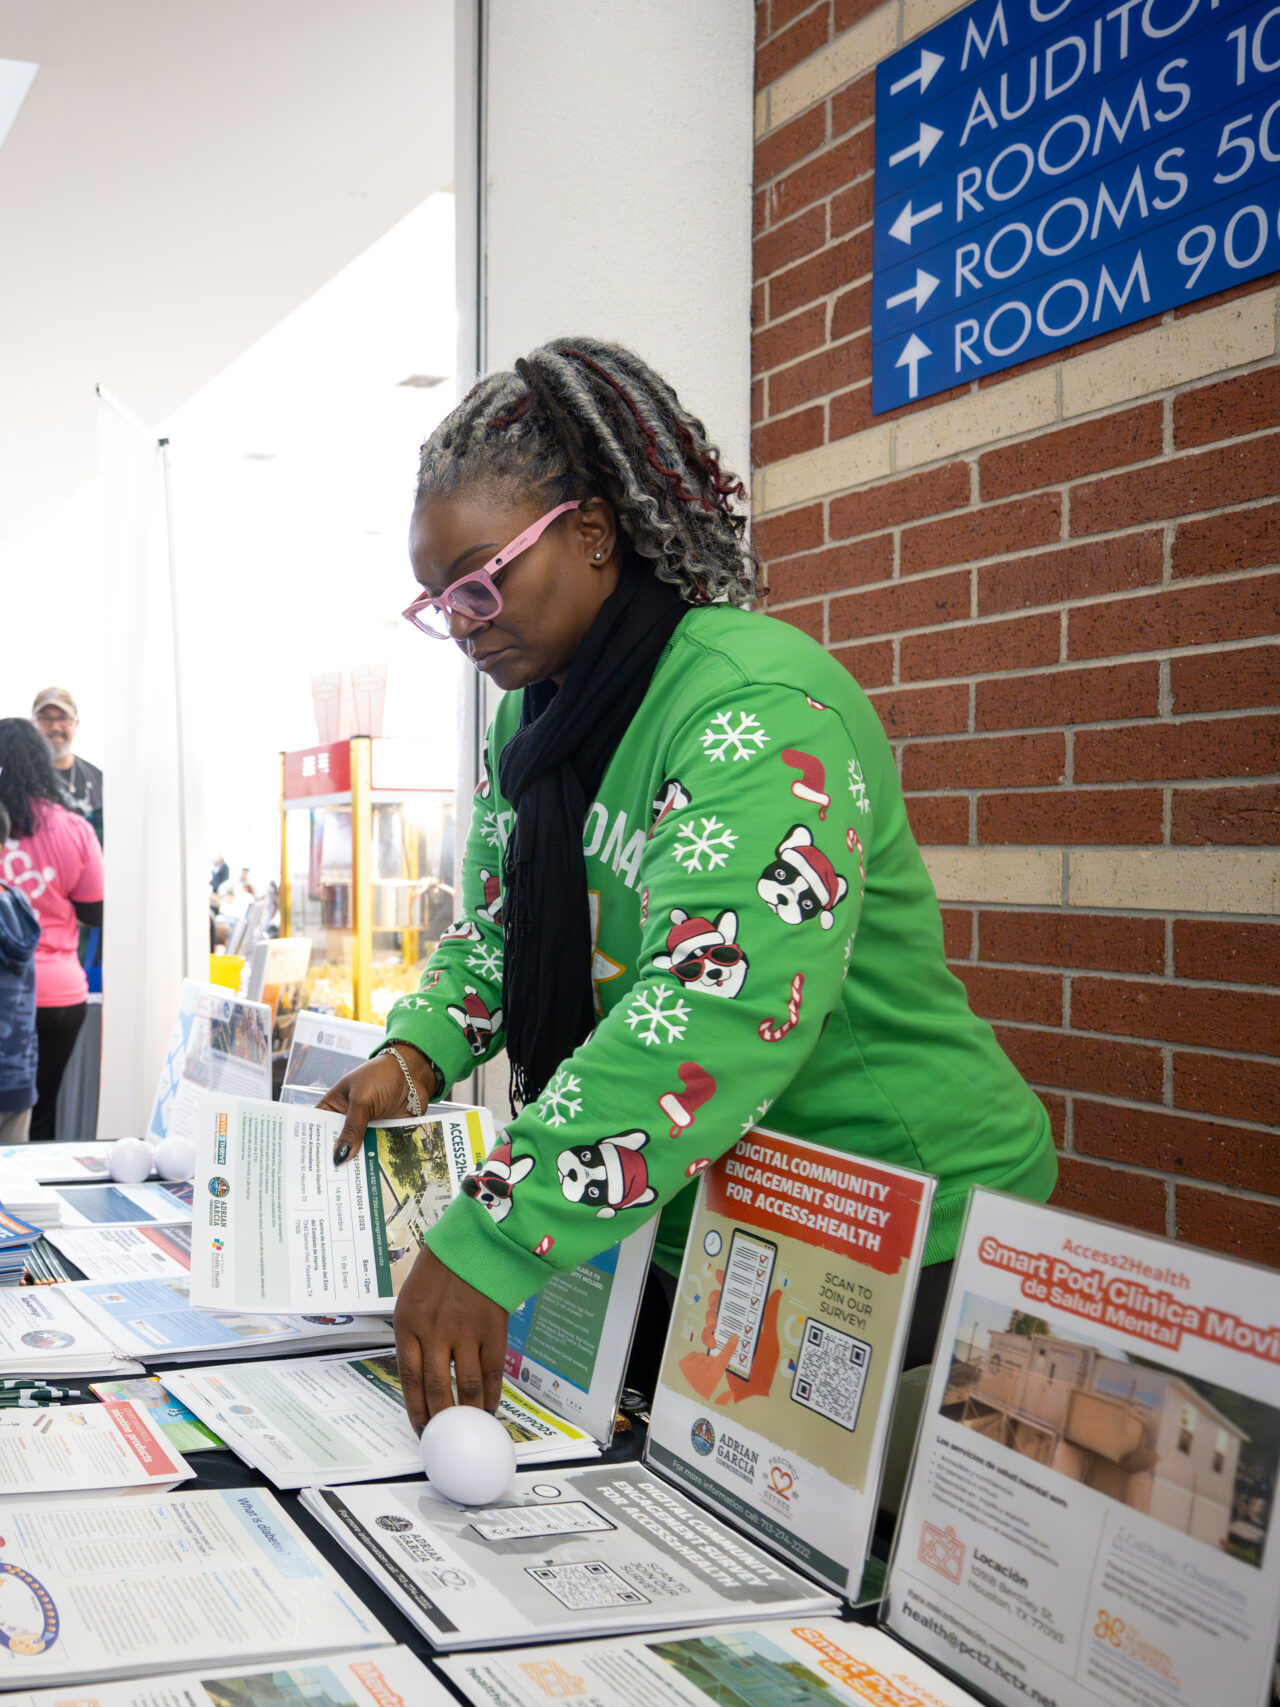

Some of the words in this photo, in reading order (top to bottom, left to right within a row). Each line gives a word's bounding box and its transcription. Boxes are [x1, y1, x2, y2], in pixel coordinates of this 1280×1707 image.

[959, 0, 1222, 147] AUDITO
[956, 58, 1191, 222] ROOMS
[955, 147, 1188, 298] ROOMS
[954, 249, 1151, 373] ROOM
[1177, 204, 1280, 289] 90
[735, 1139, 791, 1174] DIGITAL
[790, 1157, 891, 1204] COMMUNITY
[355, 1194, 364, 1210] 2024
[725, 1159, 825, 1209] ENGAGEMENT
[825, 1192, 891, 1229] SURVEY
[212, 1199, 220, 1226] GARCIA
[219, 1200, 227, 1228] ADRIAN
[335, 1202, 345, 1231] Diciembre
[357, 1214, 366, 1231] 2025
[726, 1182, 754, 1205] FOR
[754, 1192, 882, 1253] ACCESS2HEALTH
[341, 1270, 350, 1289] Enero
[361, 1259, 370, 1272] 8am
[981, 1239, 1050, 1281] Smart
[1052, 1259, 1108, 1300] Pod,
[1061, 1237, 1191, 1291] Access2Health
[363, 1277, 372, 1294] 12pm
[819, 1284, 846, 1307] JOIN
[846, 1295, 873, 1318] OUR
[824, 1271, 855, 1293] SCAN
[854, 1283, 873, 1301] TO
[819, 1301, 868, 1331] SURVEY!
[1024, 1278, 1046, 1299] de
[1048, 1285, 1102, 1319] Salud
[1106, 1304, 1179, 1346] Mental
[500, 1399, 557, 1437] SMARTPODS
[123, 1430, 155, 1465] products
[716, 1445, 758, 1478] GARCIA
[720, 1432, 759, 1464] ADRIAN
[235, 1496, 260, 1517] What
[671, 1458, 684, 1474] For
[683, 1466, 703, 1487] more
[702, 1478, 745, 1516] information
[743, 1506, 760, 1526] call:
[758, 1516, 812, 1561] 713-274-2222
[397, 1534, 433, 1563] GARCIA
[409, 1533, 447, 1562] ADRIAN
[593, 1484, 631, 1506] FOR
[617, 1503, 743, 1590] ACCESS2HEALTH
[608, 1479, 711, 1547] ENGAGEMENT
[696, 1542, 767, 1589] SURVEY
[633, 1480, 698, 1520] DIGITAL
[684, 1516, 785, 1583] COMMUNITY
[797, 1628, 868, 1675] Smart
